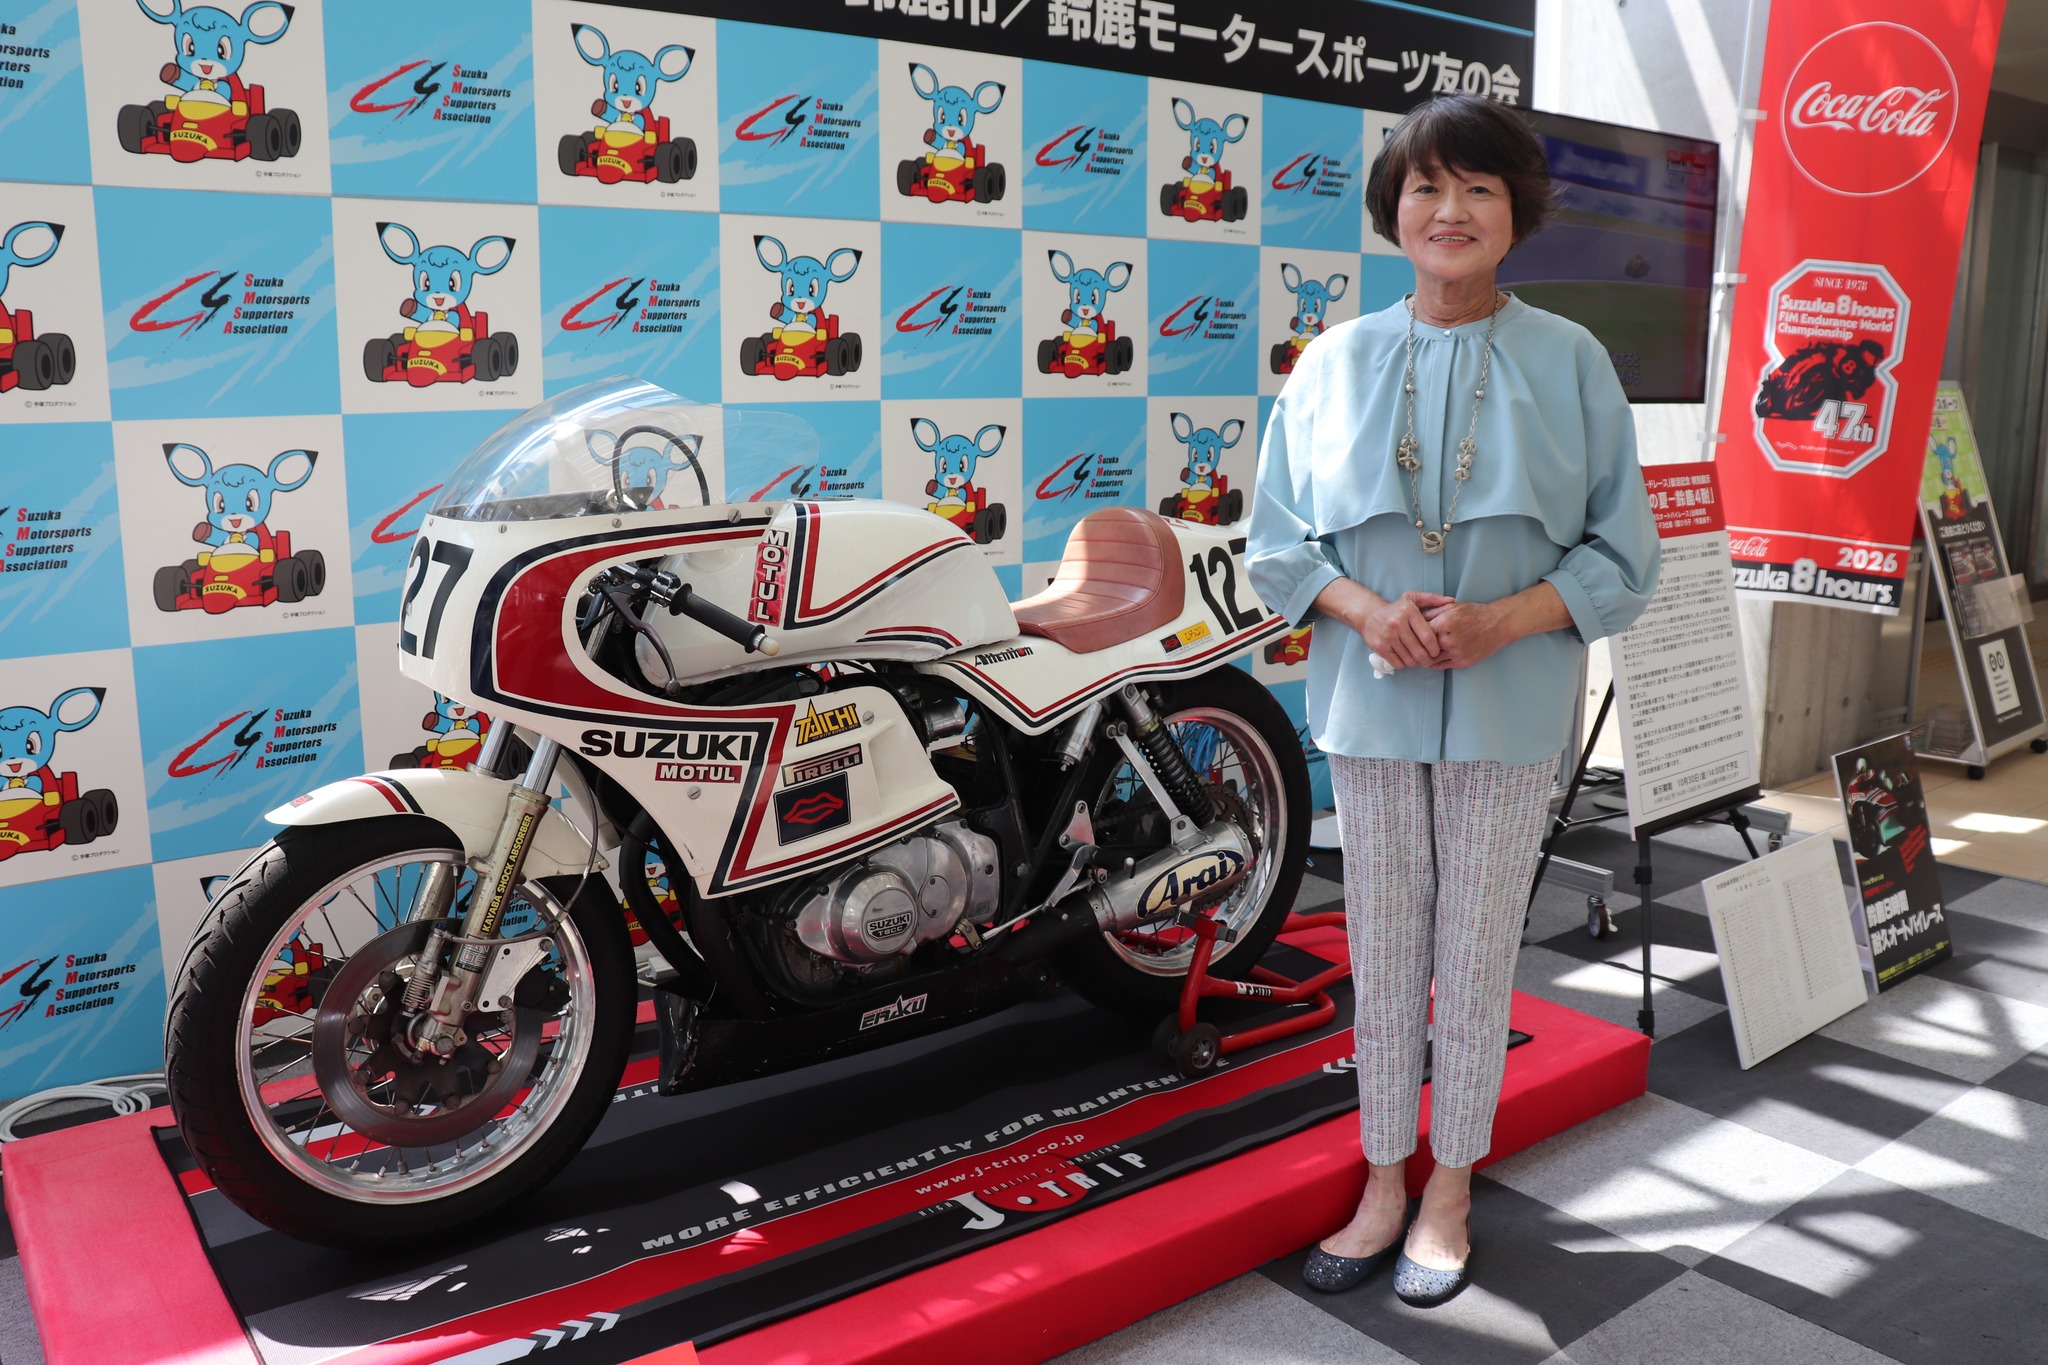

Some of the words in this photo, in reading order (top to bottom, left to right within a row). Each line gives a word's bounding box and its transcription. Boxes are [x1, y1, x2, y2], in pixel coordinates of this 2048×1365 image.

[0, 44, 50, 58] orsports
[453, 64, 488, 79] Suzuka
[452, 82, 512, 98] Motorsports
[443, 95, 496, 110] Supporters
[816, 98, 843, 112] Suzuka
[1791, 81, 1951, 136] Coca-Cola
[433, 108, 491, 124] Association
[814, 114, 861, 128] Motorsports
[172, 131, 208, 145] SUZUKA
[807, 125, 849, 138] Supporters
[1098, 128, 1120, 141] Suzuka
[800, 137, 845, 150] Association
[1097, 142, 1134, 155] Motorsports
[598, 158, 626, 169] SUZUKA
[1092, 152, 1124, 164] Supporters
[1323, 156, 1341, 167] Suzuka
[1085, 163, 1121, 175] Association
[1322, 168, 1352, 180] Motorsports
[928, 178, 951, 190] SUZUKA
[1317, 178, 1344, 188] Supporters
[1312, 186, 1341, 198] Association
[244, 274, 284, 288] Suzuka
[650, 280, 680, 292] Suzuka
[1814, 276, 1844, 290] SINCE
[1846, 278, 1868, 291] 1978
[243, 291, 310, 306] Motorsports
[967, 287, 991, 299] Suzuka
[648, 296, 700, 308] Motorsports
[966, 302, 1006, 314] Motorsports
[1215, 298, 1234, 308] Suzuka
[1780, 294, 1836, 312] Suzuka
[1836, 295, 1851, 315] 8
[1851, 300, 1896, 320] hours
[234, 306, 294, 320] Supporters
[640, 309, 688, 320] Supporters
[958, 312, 996, 324] Supporters
[1214, 310, 1247, 320] Motorsports
[223, 321, 288, 334] Association
[632, 321, 682, 333] Association
[1209, 320, 1238, 330] Supporters
[1779, 312, 1800, 322] FIM
[1801, 314, 1858, 330] Endurance
[1860, 319, 1894, 332] World
[952, 324, 992, 335] Association
[1204, 330, 1235, 340] Association
[1778, 324, 1854, 340] Championship
[410, 358, 440, 370] SUZUKA
[775, 355, 800, 366] SUZUKA
[1814, 399, 1874, 443] 47th
[1098, 454, 1119, 464] Suzuka
[820, 466, 847, 477] Suzuka
[1096, 467, 1132, 477] Motorsports
[820, 480, 864, 491] Motorsports
[1091, 478, 1123, 488] Supporters
[1085, 489, 1120, 498] Association
[17, 508, 61, 522] Suzuka
[16, 526, 92, 540] Motorsports
[6, 542, 74, 556] Supporters
[1836, 546, 1899, 572] 2026
[756, 529, 790, 620] MOTUL
[1732, 563, 1790, 592] zuka
[1792, 558, 1818, 592] 8
[1816, 569, 1894, 604] hours
[204, 584, 238, 594] SUZUKA
[274, 708, 312, 722] Suzuka
[795, 699, 859, 746] TAICHI
[274, 722, 337, 739] Motorsports
[265, 738, 322, 754] Supporters
[579, 730, 752, 761] SUZUKI
[256, 752, 317, 769] Association
[785, 746, 861, 786] PIRELLI
[660, 765, 735, 781] MOTUL
[0, 832, 20, 840] UKA
[482, 895, 502, 932] KAYABA
[496, 864, 514, 894] SHOCK
[508, 814, 533, 862] ABSORBER
[1147, 851, 1233, 916] Arai
[870, 914, 910, 931] SUZUKI
[878, 926, 903, 936] TSCC
[66, 952, 108, 968] Suzuka
[65, 963, 136, 985] Motorsports
[56, 980, 120, 1001] Supporters
[46, 996, 114, 1018] Association
[914, 1132, 1086, 1196] www.j-trip.co.jp
[641, 1209, 752, 1250] MORE
[764, 1140, 973, 1212] EFFICIENTLY
[984, 1113, 1044, 1143] FOR
[919, 1200, 953, 1218] HIGH
[982, 1172, 1040, 1196] QUALITY
[1058, 1143, 1122, 1170] FUNCTION
